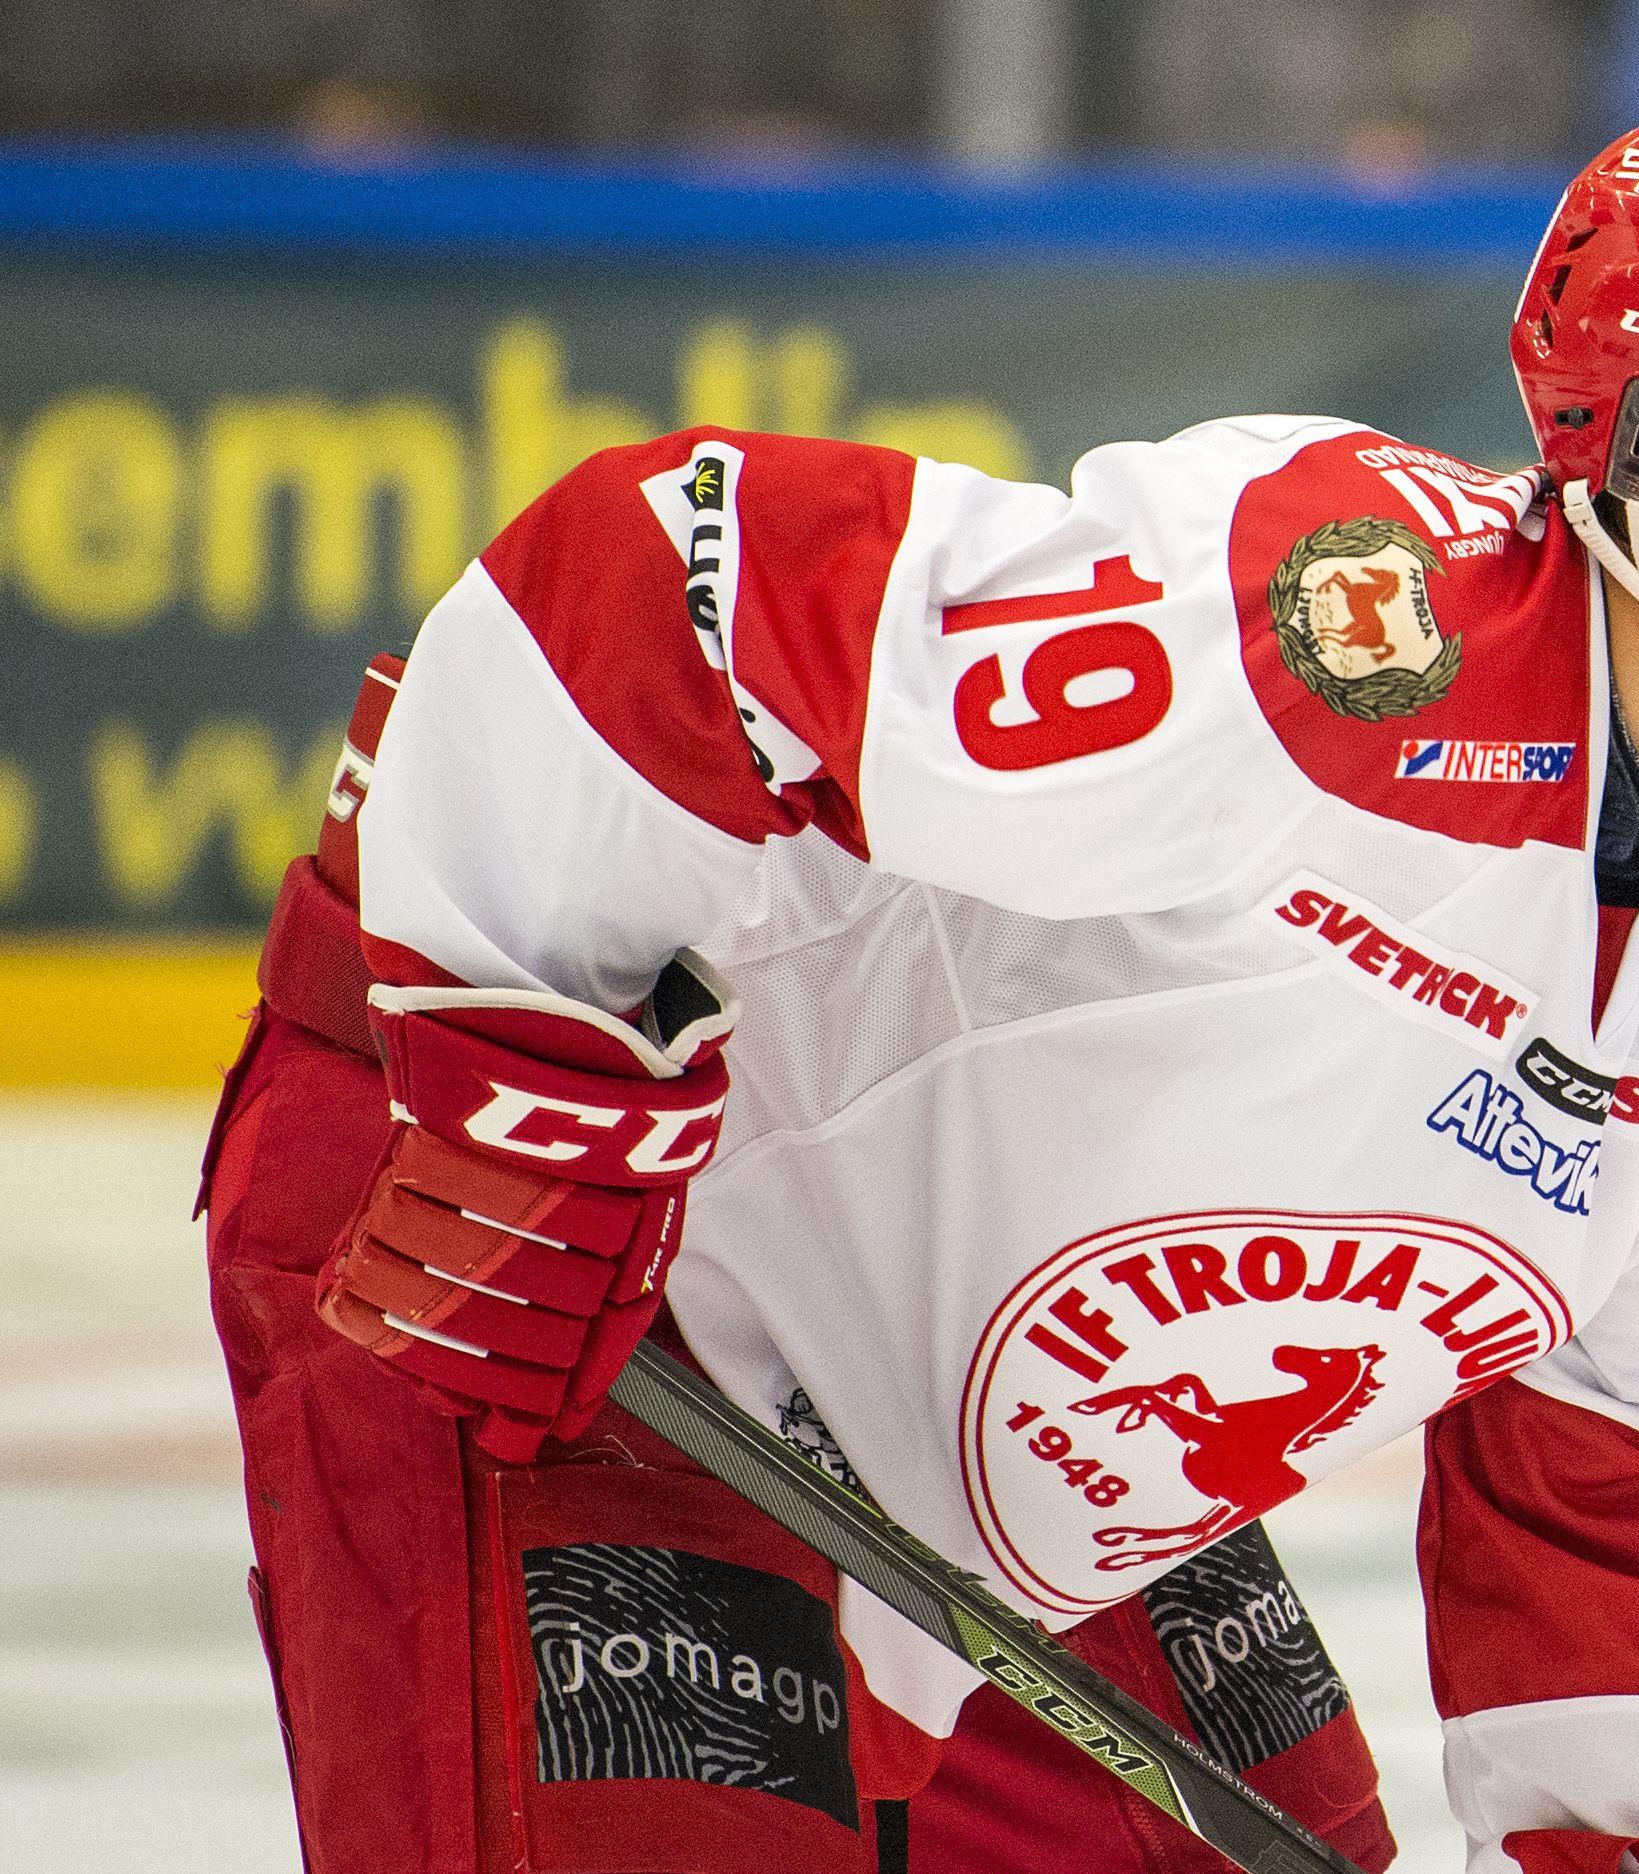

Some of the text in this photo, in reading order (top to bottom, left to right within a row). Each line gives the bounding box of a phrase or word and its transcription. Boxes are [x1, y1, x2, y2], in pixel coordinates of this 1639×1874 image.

[941, 553, 1175, 773] 19
[1023, 1234, 1541, 1395] IF TROJA-LJU
[1005, 1401, 1131, 1509] 1948
[976, 1644, 1154, 1775] CCM
